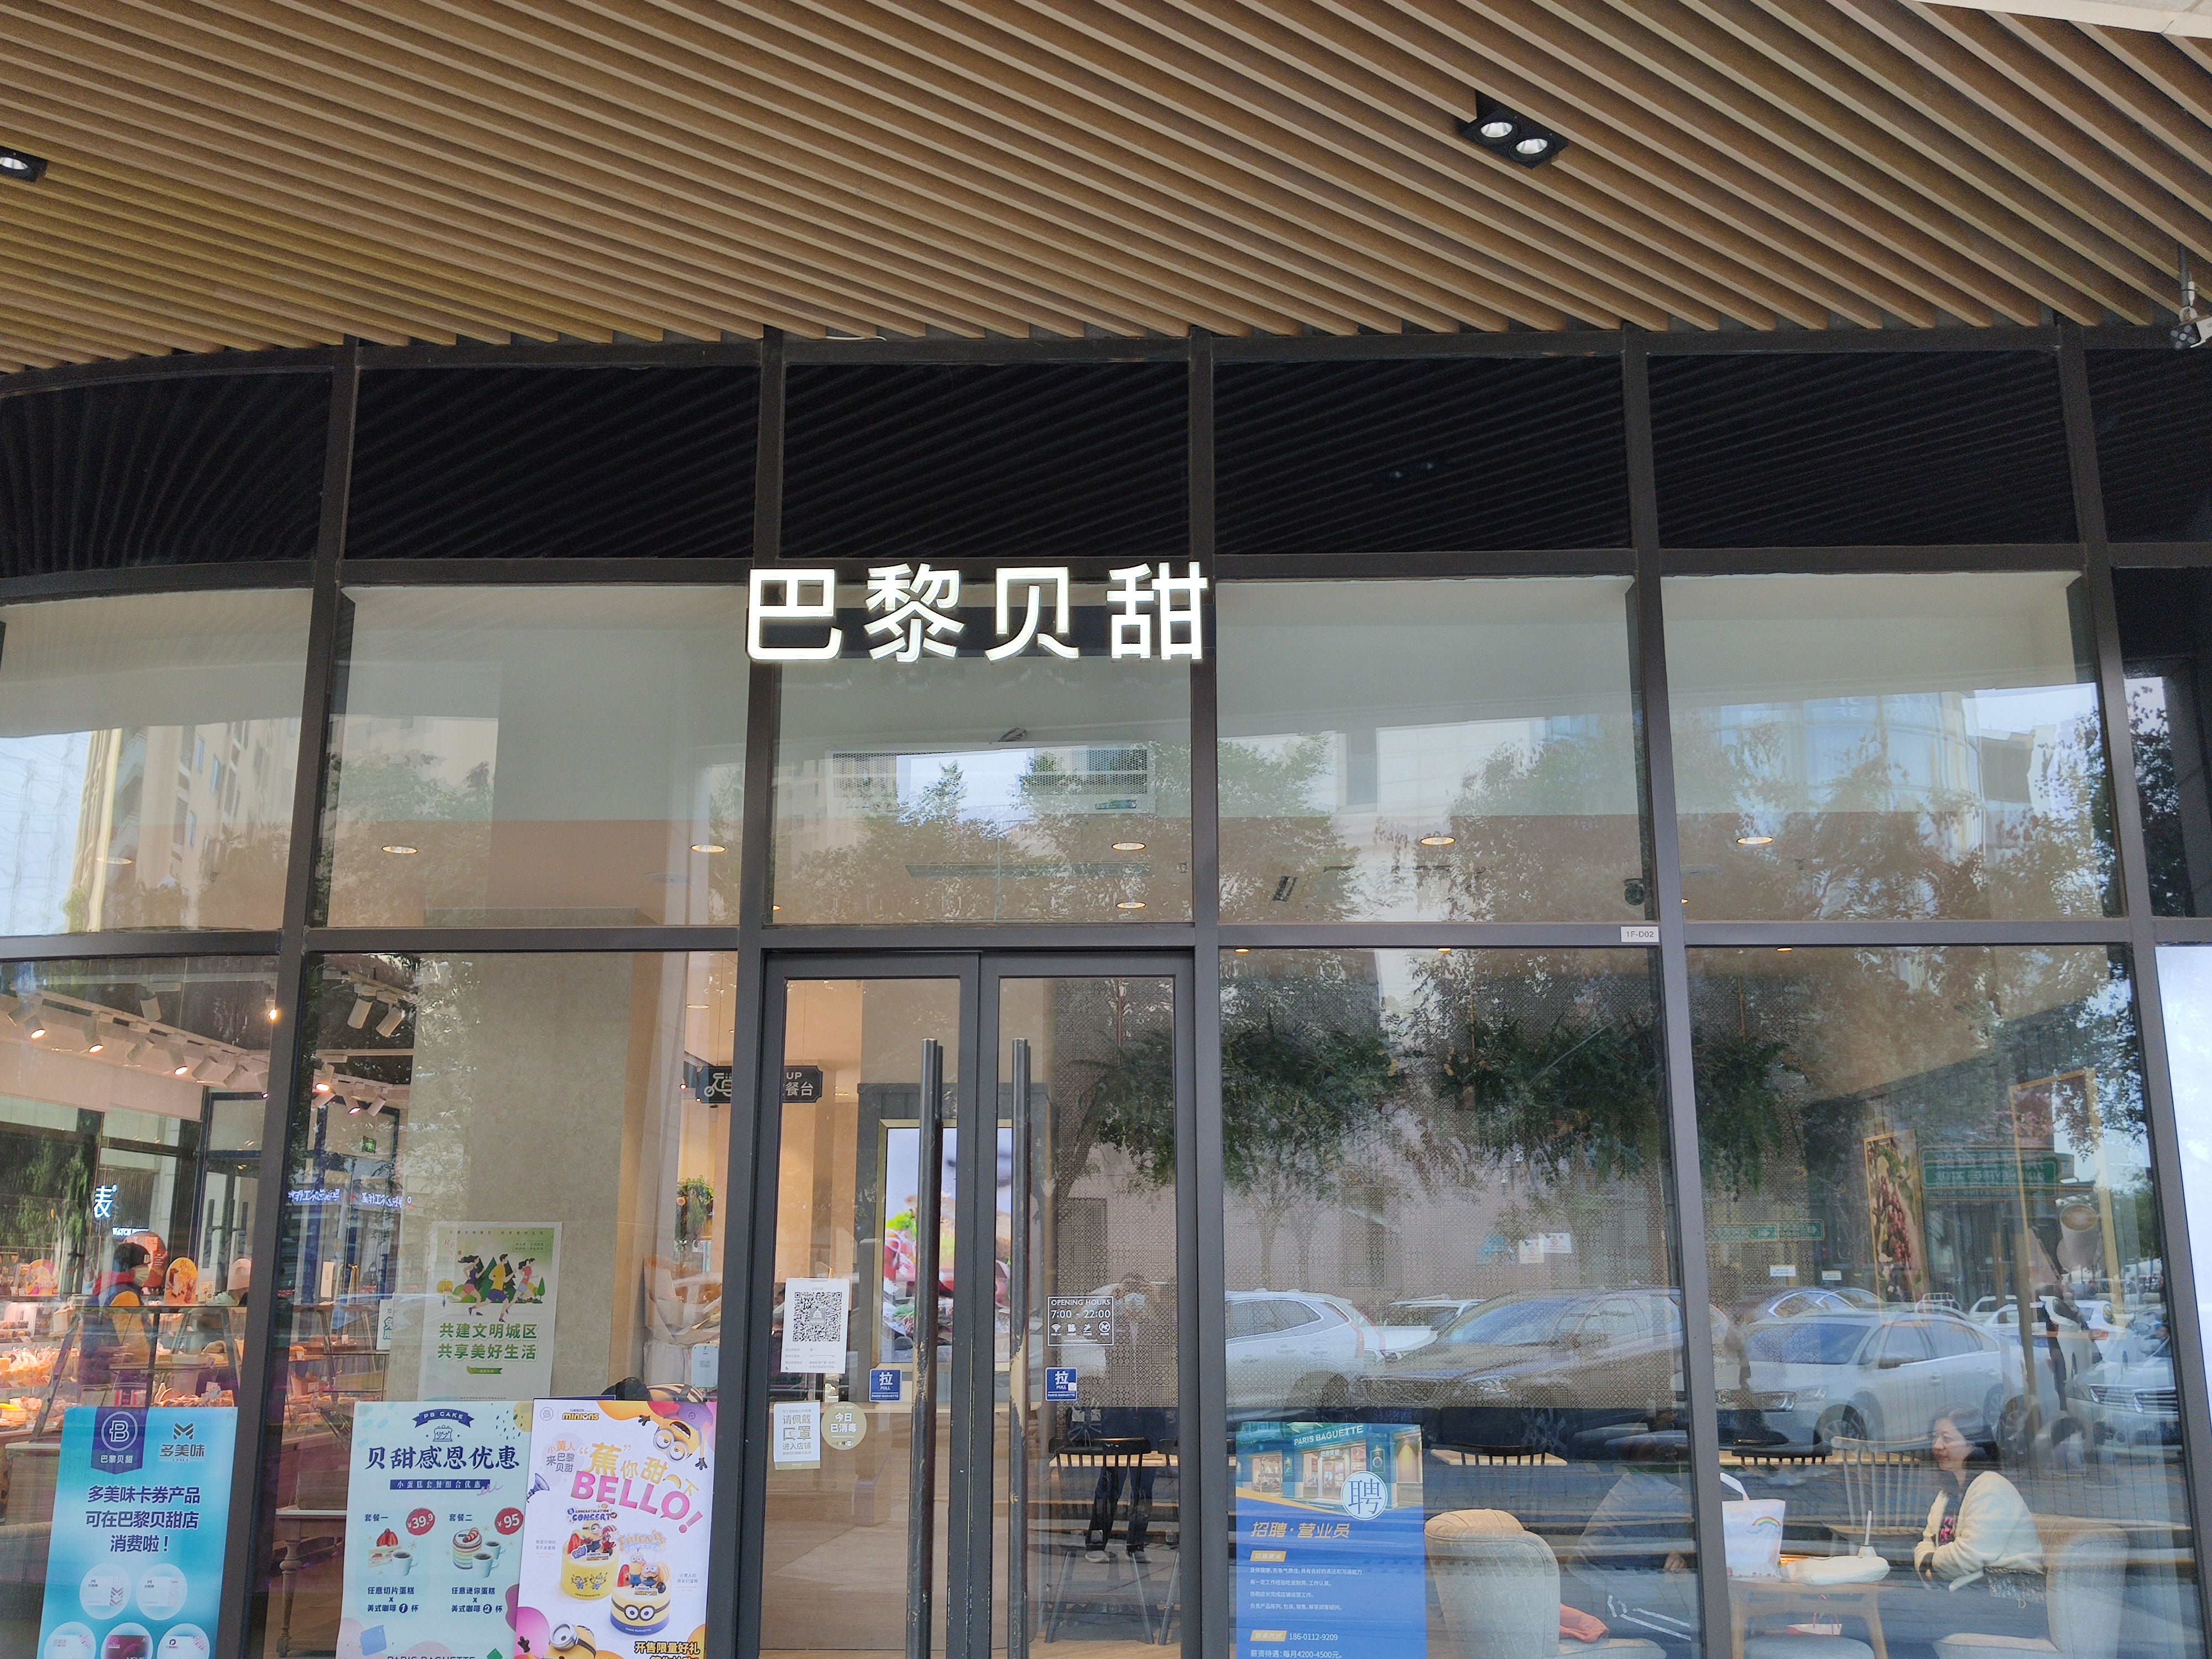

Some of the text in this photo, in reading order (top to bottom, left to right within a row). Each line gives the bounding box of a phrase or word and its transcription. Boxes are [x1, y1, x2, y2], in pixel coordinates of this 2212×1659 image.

[746, 561, 1208, 662] 巴黎贝甜
[786, 1072, 802, 1080] UP
[782, 1082, 813, 1096] 餐台
[93, 1184, 113, 1218] 表
[112, 1227, 132, 1236] WATCH
[1051, 1310, 1072, 1319] 7:00
[1083, 1309, 1110, 1318] 22:00
[440, 1323, 538, 1339] 共建文明城区
[437, 1343, 537, 1360] 共享美好生活
[879, 1371, 893, 1386] 拉
[1055, 1370, 1068, 1385] 拉
[440, 1411, 463, 1420] CAKE
[782, 1414, 811, 1425] 请佩戴
[834, 1412, 853, 1422] 今日
[830, 1422, 857, 1433] 已消毒
[1294, 1425, 1364, 1446] PARIS BAGUETTE
[159, 1444, 205, 1457] 多美味
[548, 1440, 576, 1454] 小黄人
[782, 1442, 811, 1450] 进入店铺
[100, 1455, 133, 1464] 巴黎贝甜
[364, 1445, 520, 1470] 贝甜感恩优惠
[397, 1480, 481, 1489] 小蛋糕套餐组合优惠
[87, 1485, 200, 1504] 多美味卡券产品
[570, 1470, 703, 1533] BELLO!
[1348, 1478, 1383, 1515] 聘
[86, 1510, 199, 1529] 可在巴黎贝甜店
[497, 1513, 520, 1528] ¥95
[572, 1513, 611, 1521] CONCERT
[1250, 1521, 1350, 1539] 招聘·营业员
[109, 1535, 169, 1553] 消费啦！
[368, 1587, 415, 1595] 任意切片蛋糕
[451, 1587, 495, 1595] 任意迷你蛋糕
[367, 1604, 397, 1613] 美式咖啡
[634, 1641, 701, 1655] 开售限量好礼
